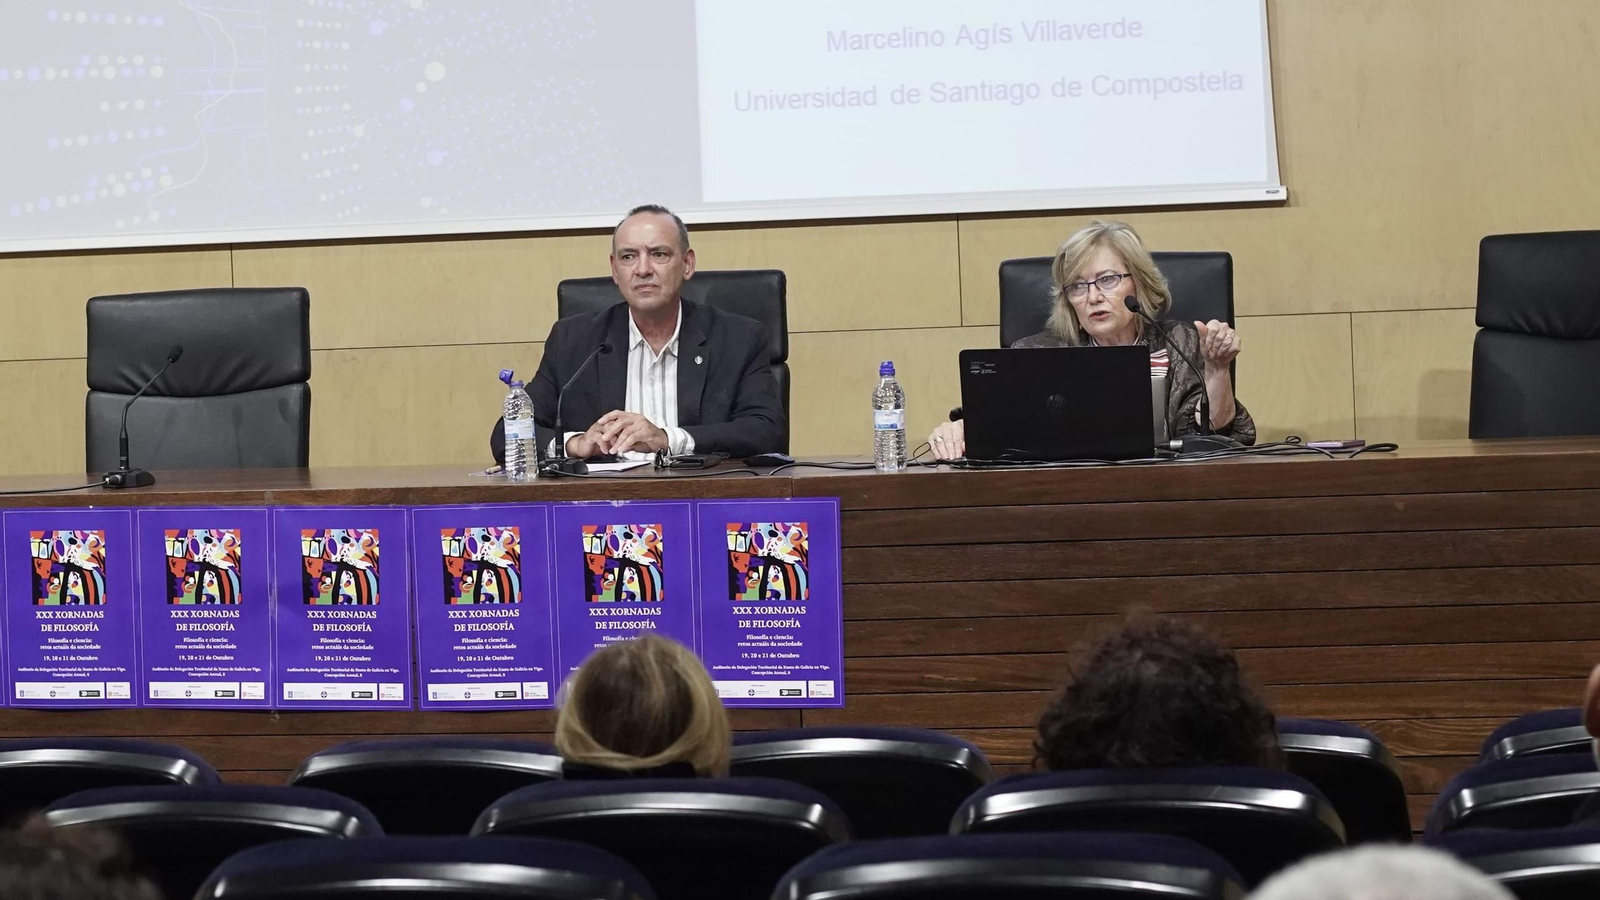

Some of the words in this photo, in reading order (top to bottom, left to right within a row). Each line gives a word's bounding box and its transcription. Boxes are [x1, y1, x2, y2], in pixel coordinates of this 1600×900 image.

[826, 26, 945, 53] Marcelino
[954, 22, 1014, 52] Agís
[1021, 16, 1144, 43] Villaverde
[733, 84, 877, 113] Universidad
[889, 83, 922, 106] de
[930, 80, 1041, 107] Santiago
[1050, 76, 1084, 99] de
[1090, 69, 1244, 101] Compostela
[35, 611, 53, 619] XXX
[55, 610, 104, 619] XORNADAS
[170, 610, 189, 618] XXX
[190, 610, 240, 618] XORNADAS
[307, 610, 325, 618] XXX
[327, 610, 377, 619] XORNADAS
[448, 610, 467, 618] XXX
[469, 609, 520, 618] XORNADAS
[589, 608, 608, 616] XXX
[610, 608, 661, 616] XORNADAS
[733, 606, 752, 614] XXX
[754, 607, 806, 615] XORNADAS
[41, 624, 52, 632] DE
[54, 621, 99, 632] FILOSOFÍA
[176, 623, 188, 631] DE
[189, 621, 235, 631] FILOSOFÍA
[326, 622, 372, 631] FILOSOFÍA
[454, 624, 466, 632] DE
[467, 621, 515, 631] FILOSOFÍA
[595, 621, 607, 629] DE
[608, 619, 656, 629] FILOSOFÍA
[738, 620, 751, 628] DE
[752, 618, 801, 628] FILOSOFÍA
